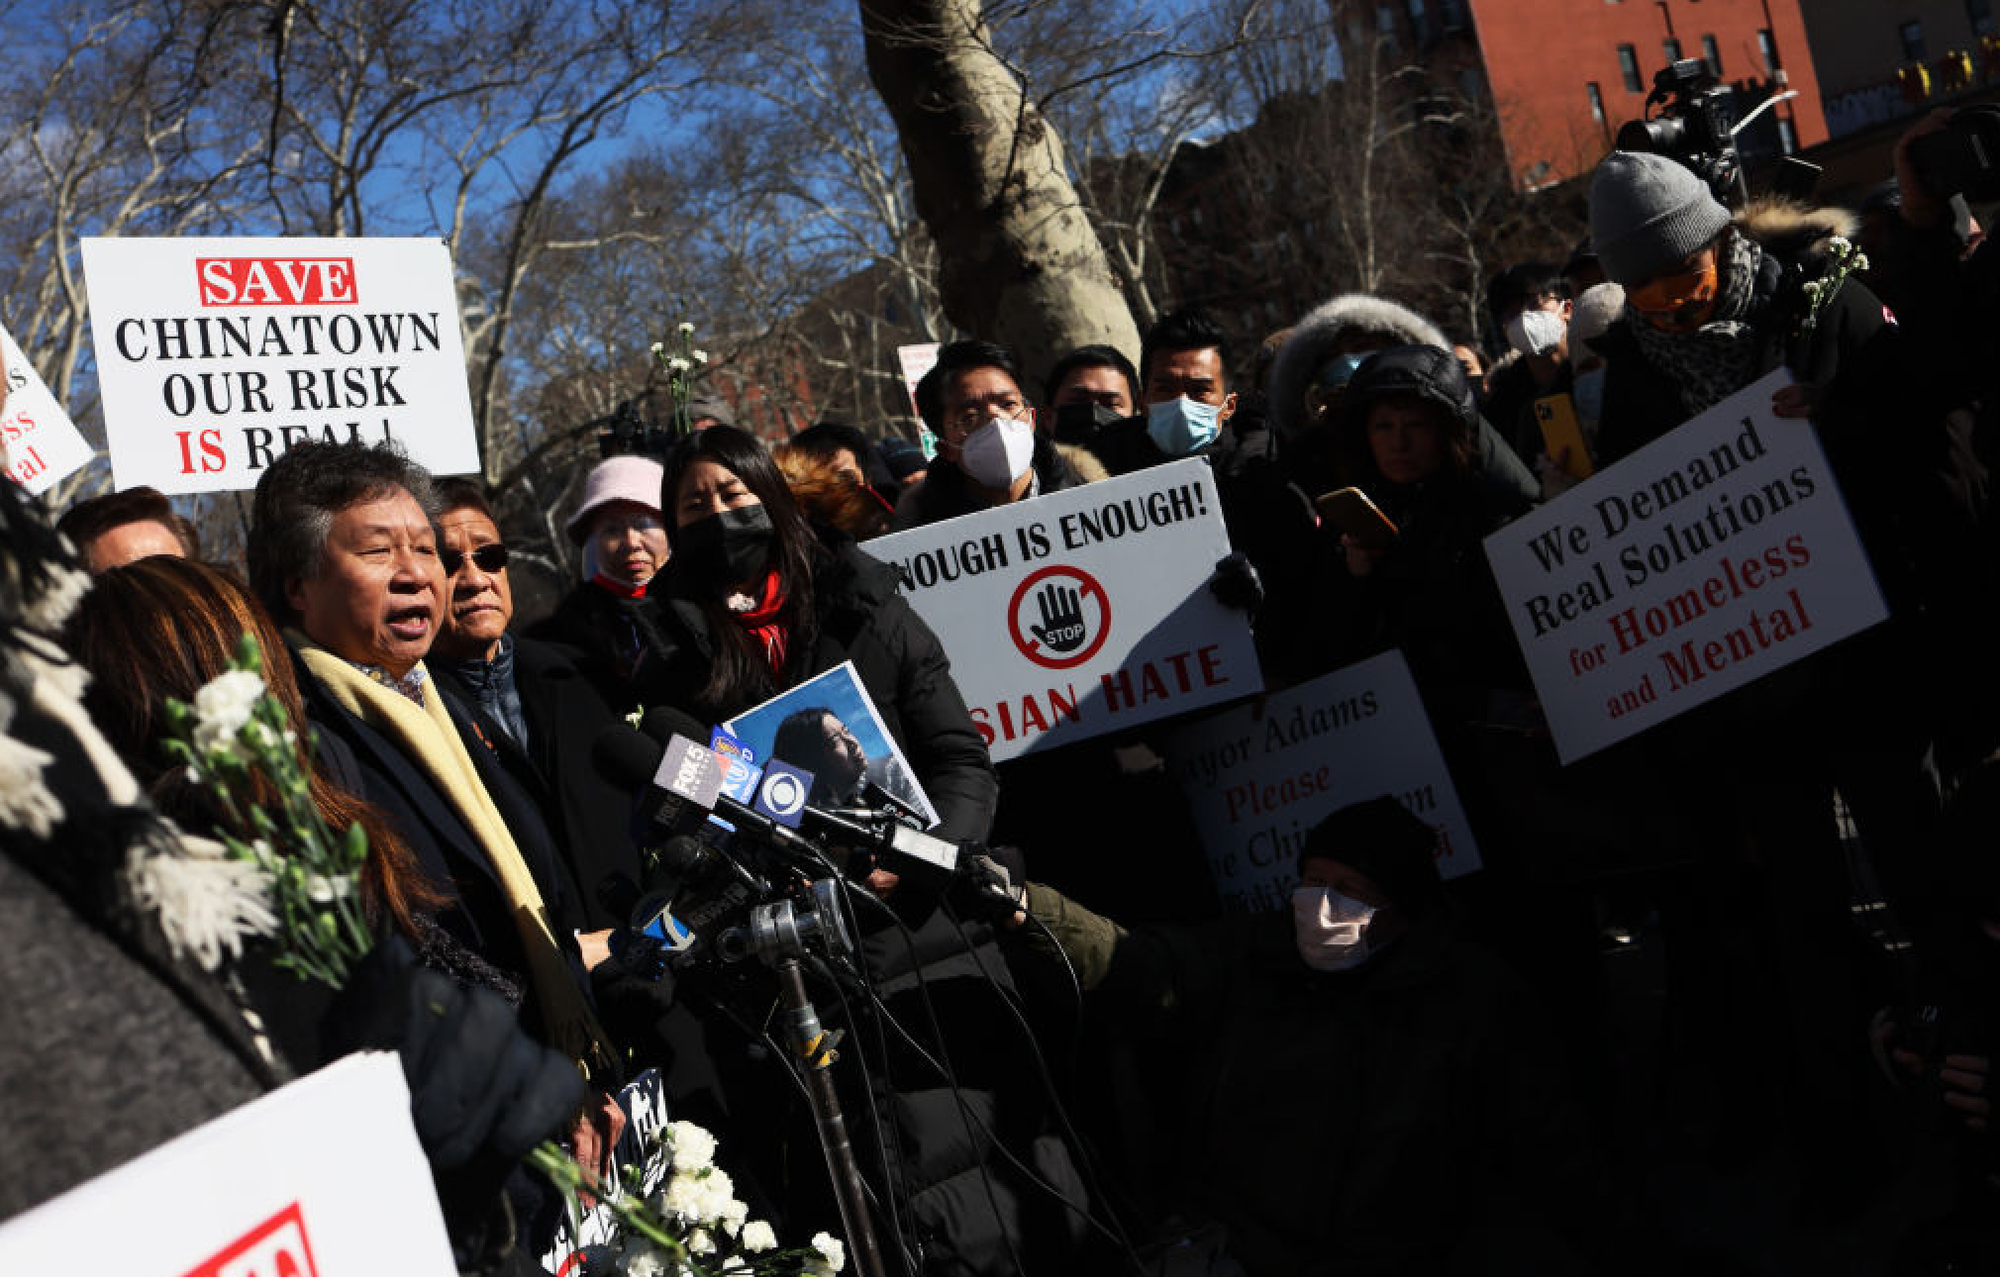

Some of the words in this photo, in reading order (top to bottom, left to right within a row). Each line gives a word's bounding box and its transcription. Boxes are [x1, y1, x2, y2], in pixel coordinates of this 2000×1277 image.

[202, 261, 353, 304] SAVE
[115, 311, 442, 362] CHINATOWN
[163, 371, 274, 417] OUR
[288, 366, 407, 411] RISK
[175, 429, 228, 474] IS
[1527, 523, 1591, 574] We
[1593, 415, 1768, 540] Demand
[894, 532, 1009, 594] NOUGH
[1015, 522, 1052, 562] IS
[1058, 481, 1208, 551] ENOUGH!
[1523, 562, 1615, 638] Real
[1618, 465, 1816, 589] Solutions
[1044, 622, 1085, 645] STOP
[1569, 640, 1607, 677] for
[1607, 534, 1812, 656] Homeless
[1605, 673, 1658, 720] and
[1658, 589, 1814, 692] Mental
[968, 681, 1082, 747] SIAN
[1099, 644, 1230, 712] HATE
[1264, 689, 1378, 753] Adams
[1221, 763, 1331, 824] Please
